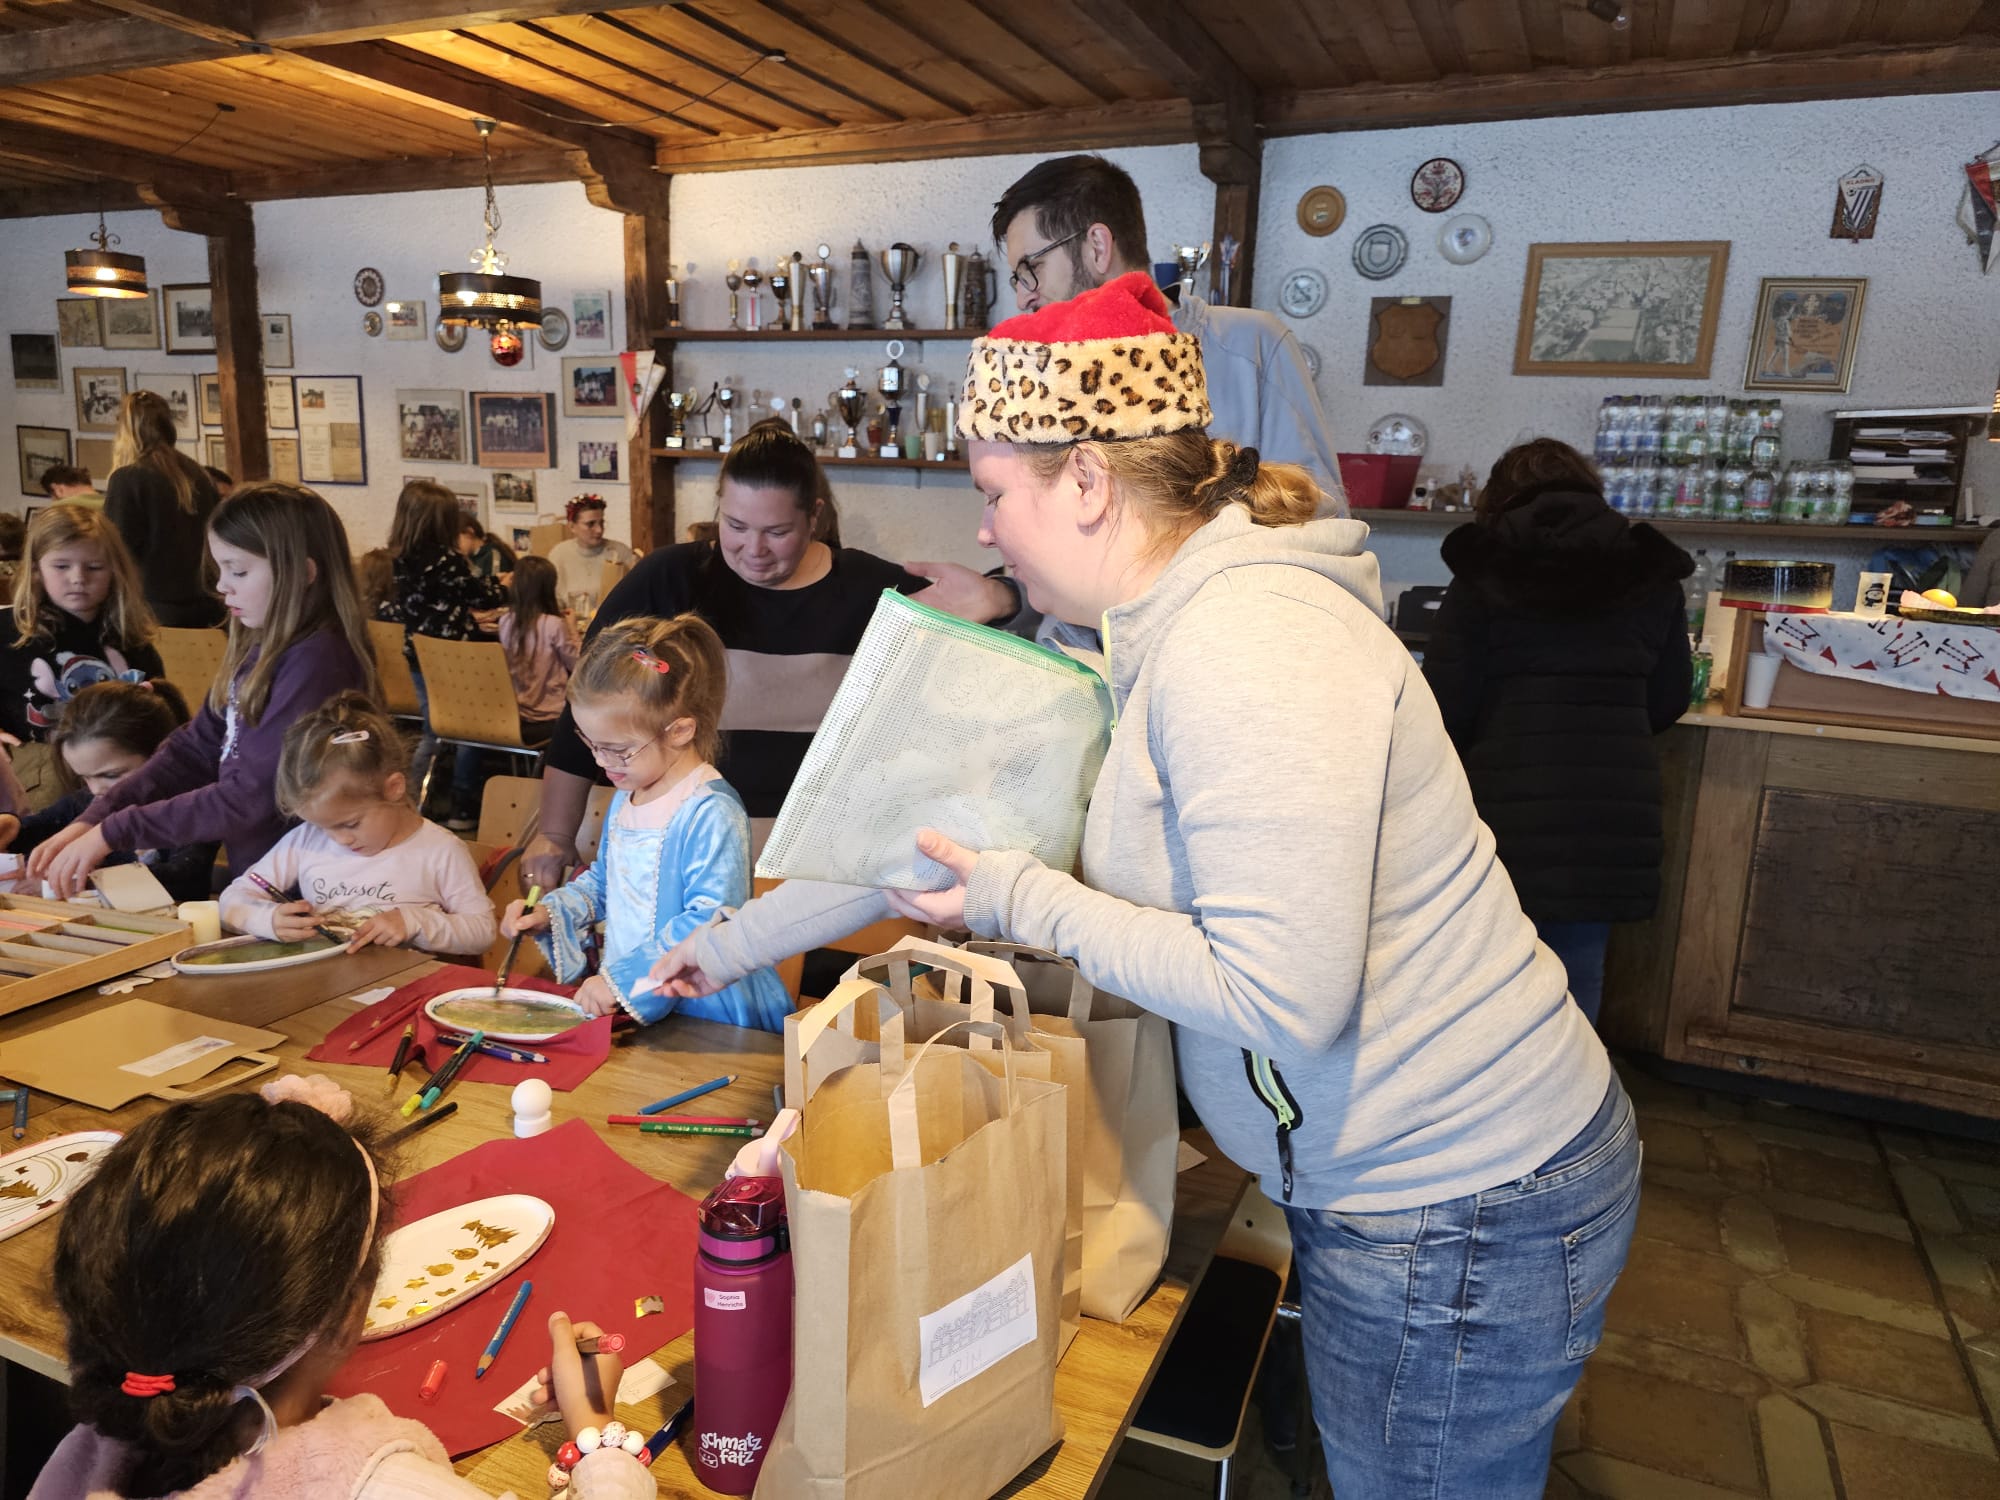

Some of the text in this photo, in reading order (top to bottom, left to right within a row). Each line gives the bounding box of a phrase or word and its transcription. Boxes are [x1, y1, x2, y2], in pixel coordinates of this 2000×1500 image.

[312, 878, 397, 905] Sarasota
[700, 1431, 763, 1451] schmatz
[719, 1448, 755, 1467] fatz
